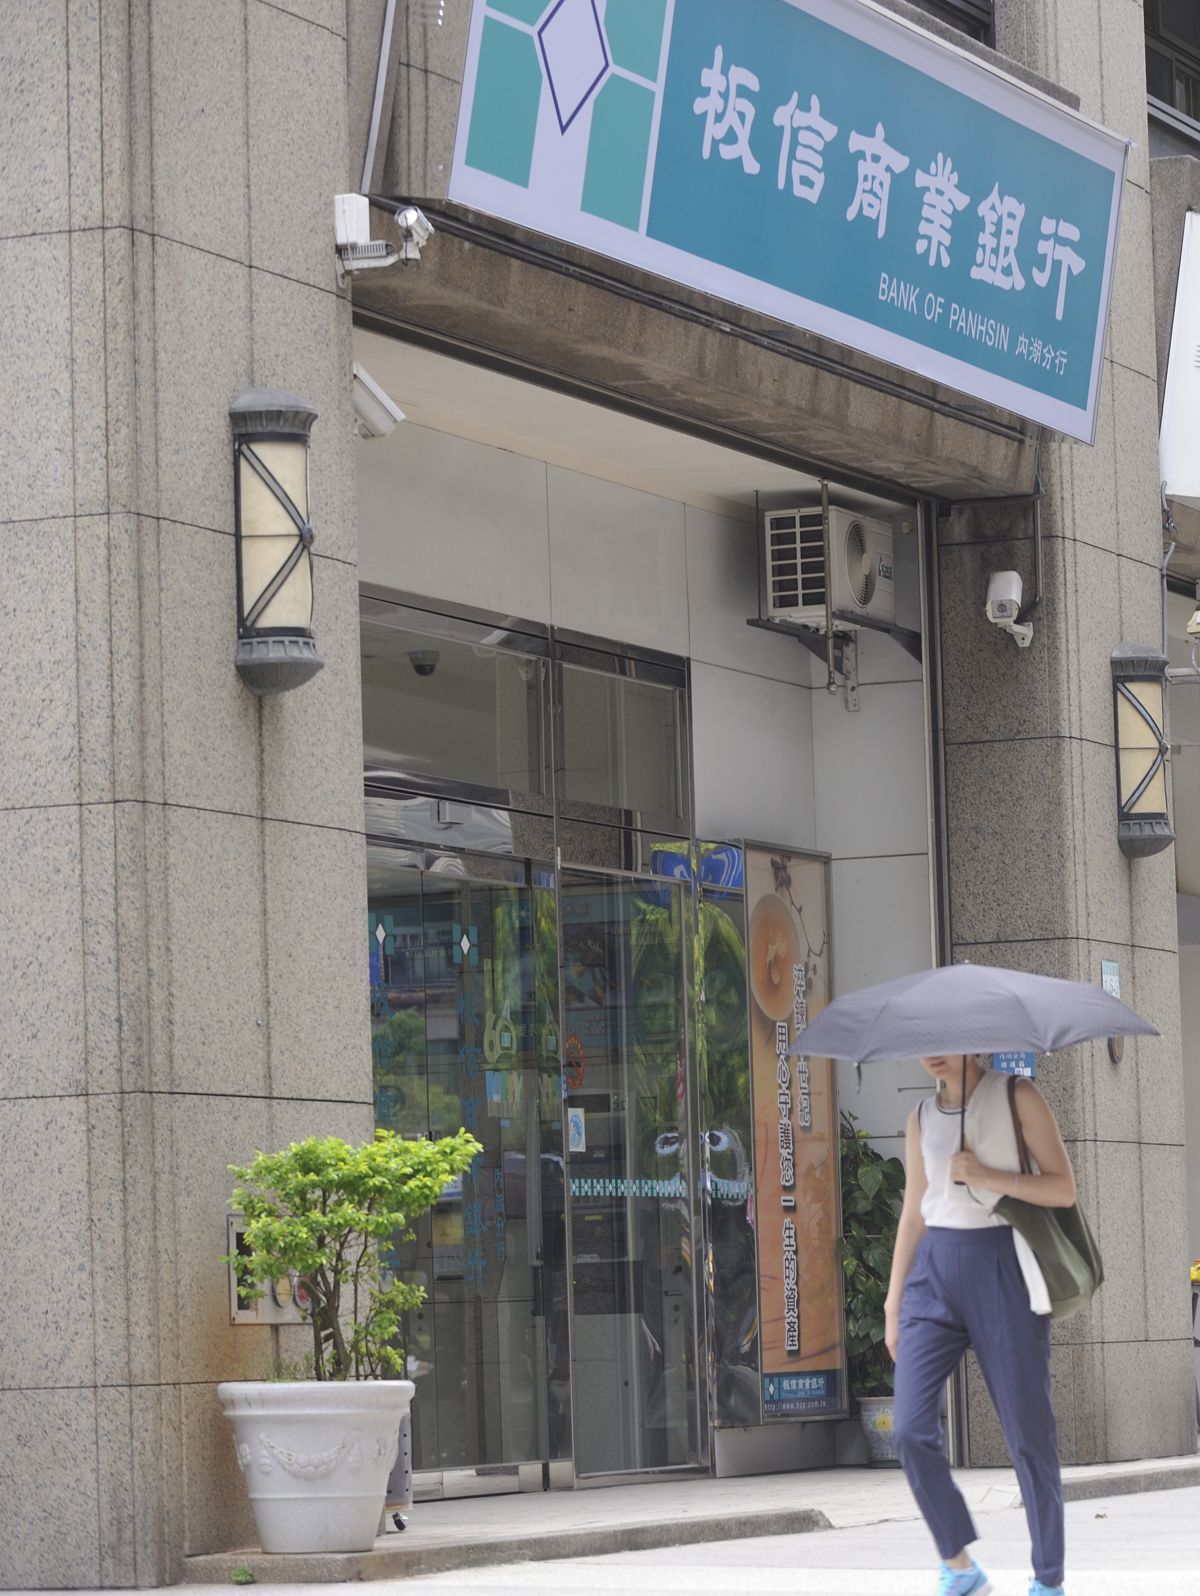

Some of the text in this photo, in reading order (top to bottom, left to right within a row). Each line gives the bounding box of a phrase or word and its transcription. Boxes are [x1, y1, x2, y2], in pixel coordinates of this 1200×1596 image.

[693, 44, 1087, 322] 板信商業銀行
[878, 272, 1010, 354] BANK OF PANHSIN
[1015, 334, 1069, 377] 內湖分行
